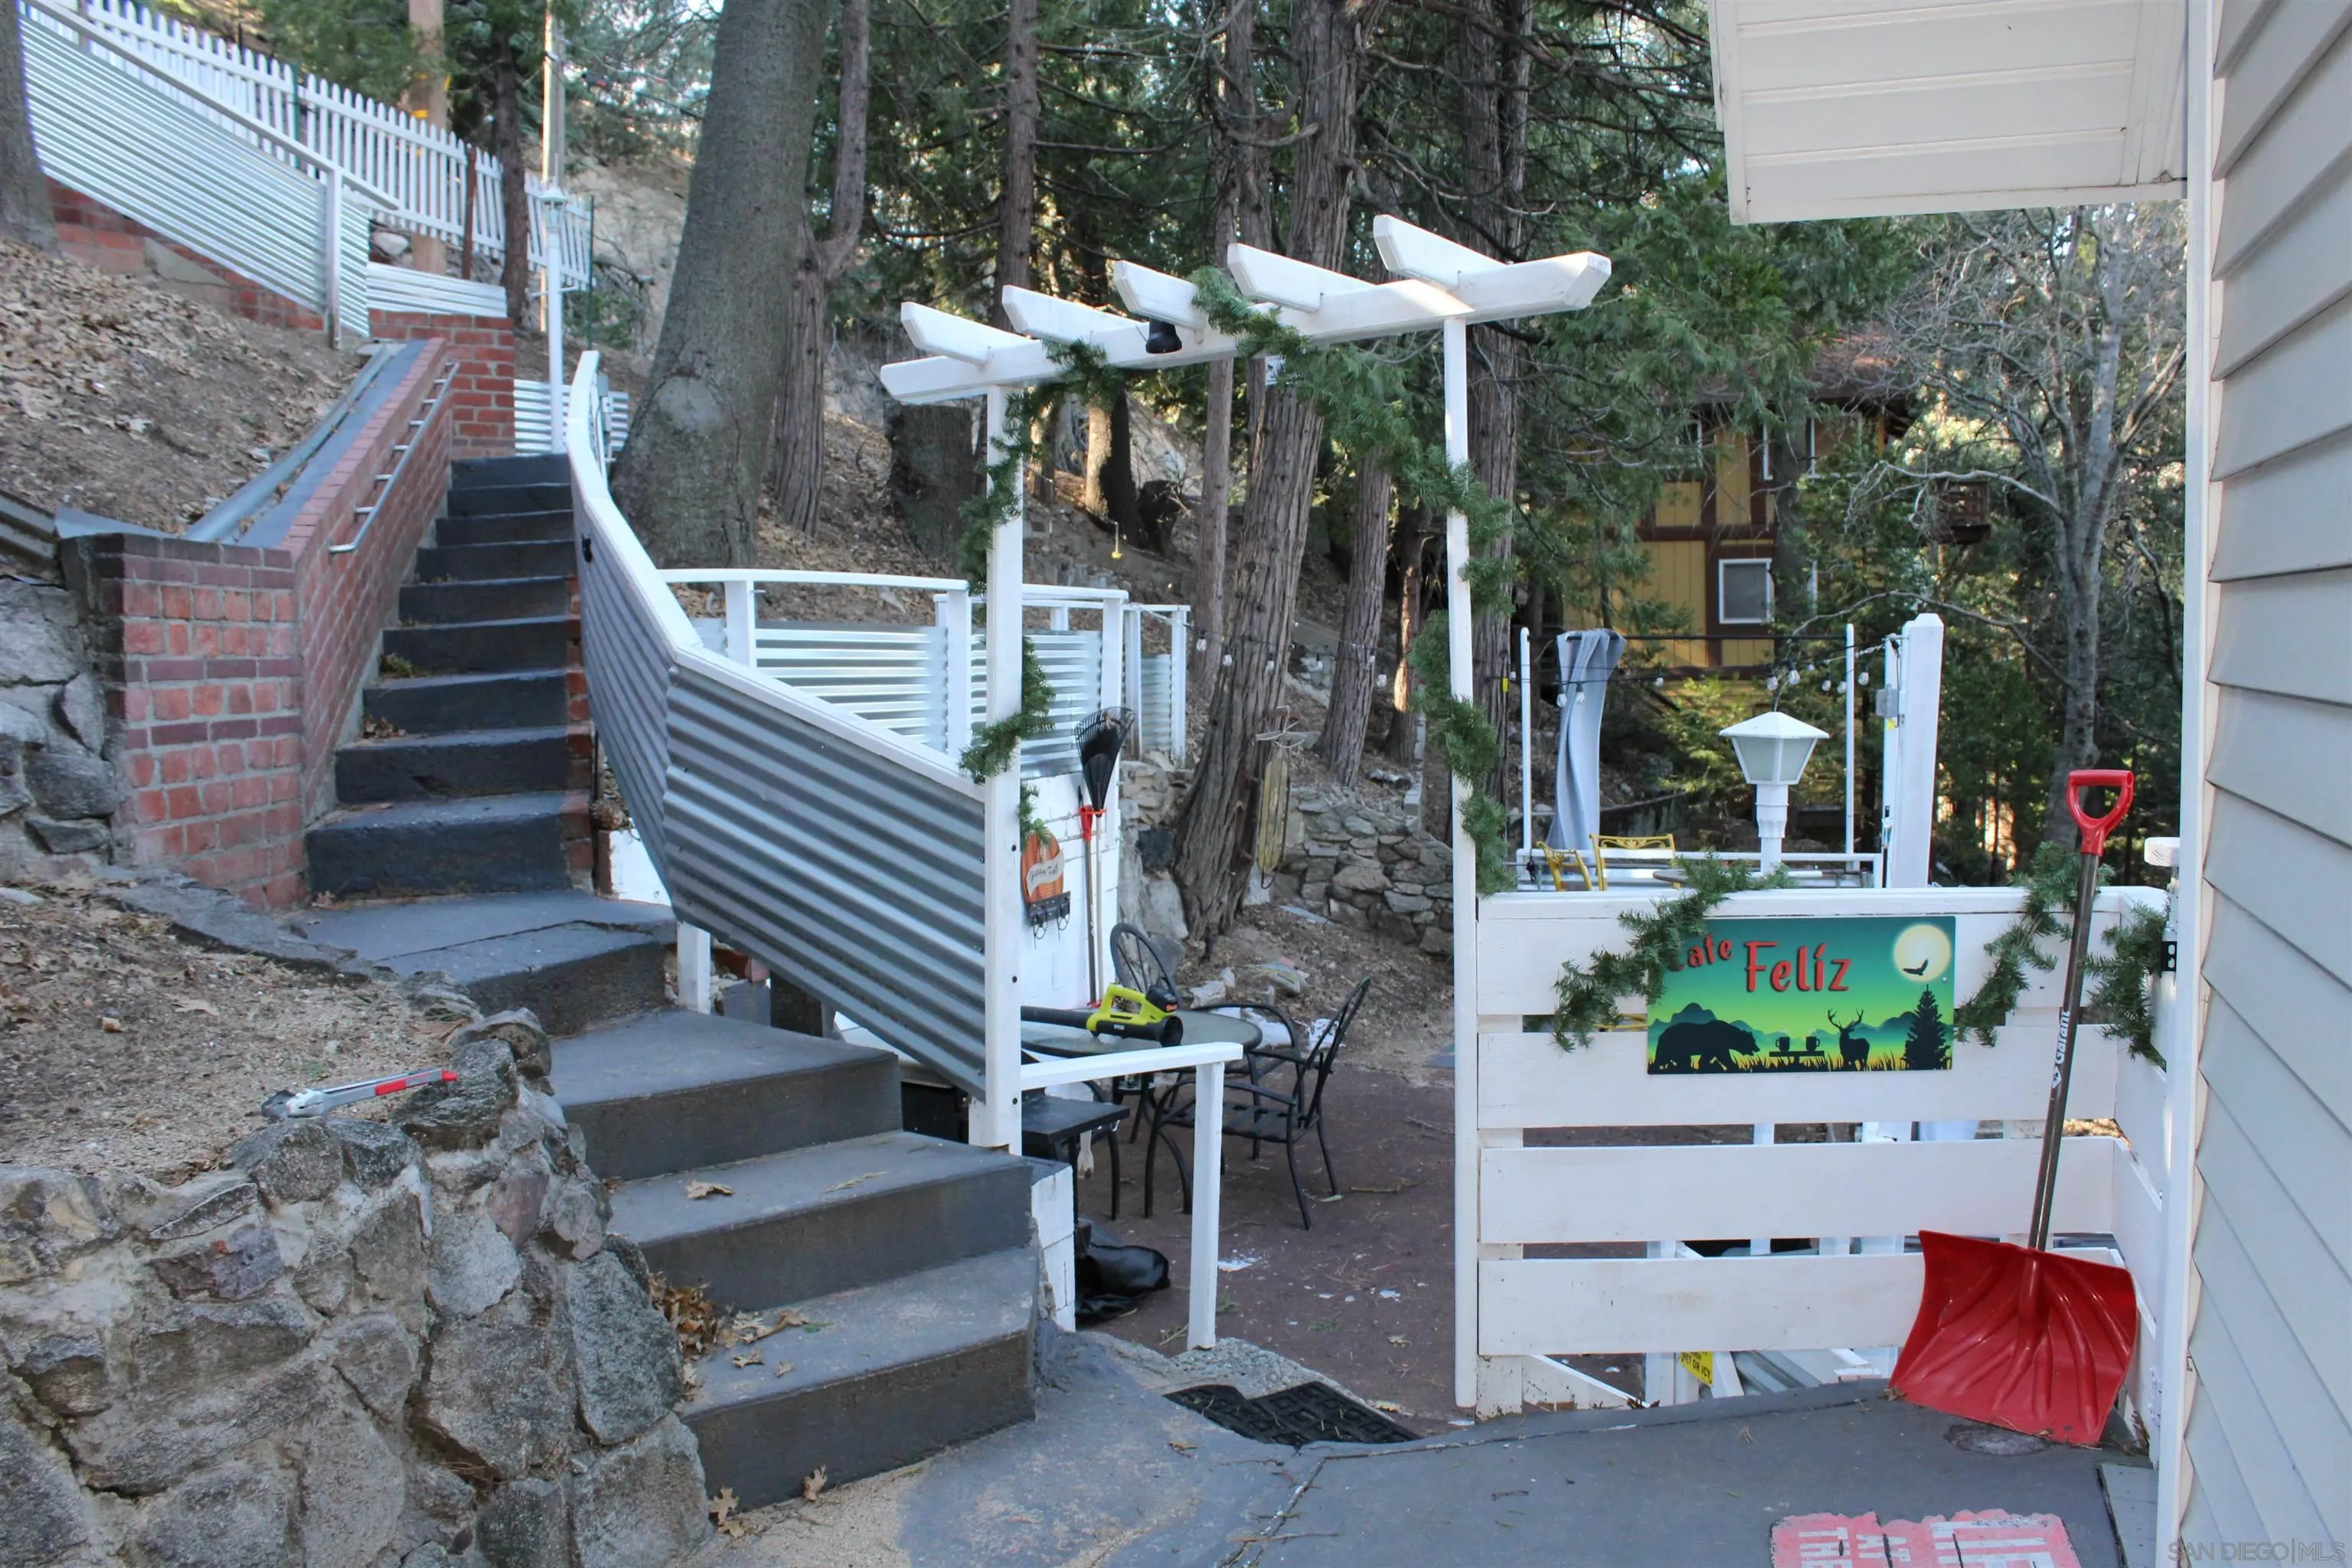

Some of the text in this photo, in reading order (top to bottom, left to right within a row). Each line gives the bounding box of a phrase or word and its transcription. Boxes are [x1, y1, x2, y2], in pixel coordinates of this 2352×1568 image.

[1668, 933, 1733, 973] afe
[1693, 1359, 1700, 1373] OR
[1701, 1365, 1711, 1379] ICY
